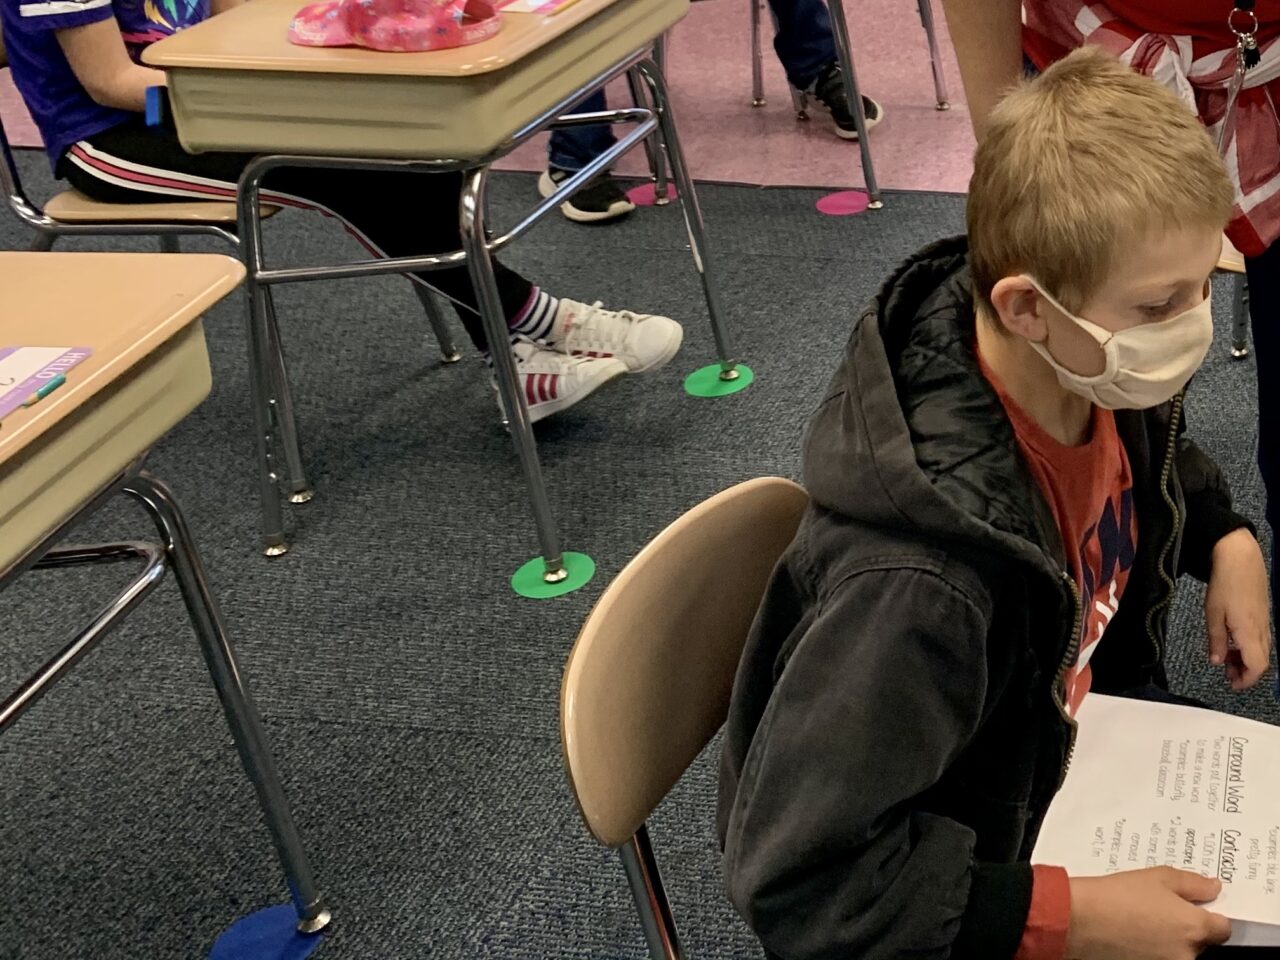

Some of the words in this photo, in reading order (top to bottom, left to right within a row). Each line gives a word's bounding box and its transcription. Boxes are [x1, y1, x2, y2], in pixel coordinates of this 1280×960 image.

[36, 351, 83, 379] HELLO
[1229, 737, 1248, 782] Compound
[1226, 786, 1244, 814] Word
[1221, 830, 1241, 883] Contraction
